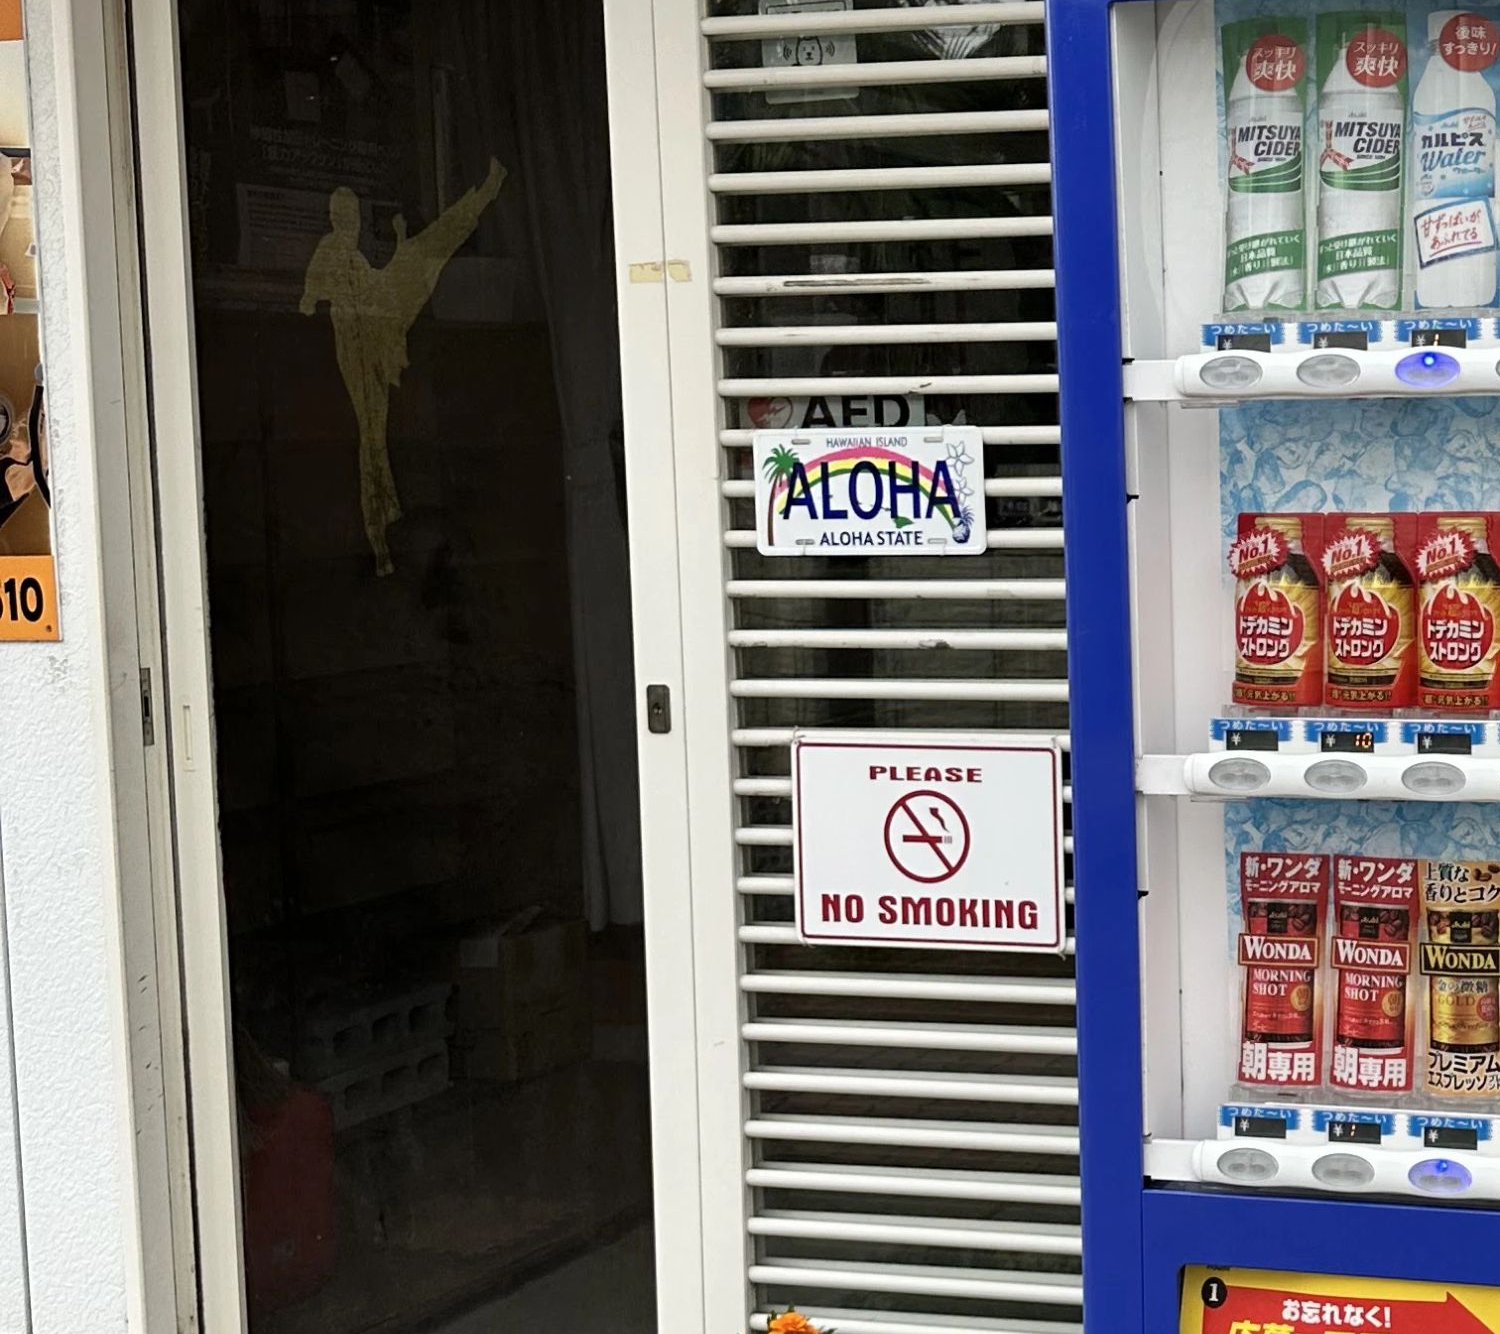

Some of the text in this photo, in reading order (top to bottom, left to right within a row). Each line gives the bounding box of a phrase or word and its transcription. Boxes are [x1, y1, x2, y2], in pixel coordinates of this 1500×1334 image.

[1354, 43, 1399, 53] スッキリ
[1443, 43, 1498, 56] すっきり!
[1354, 56, 1399, 77] 爽快
[1421, 133, 1484, 149] カルピス
[1418, 149, 1487, 174] Water
[826, 437, 907, 447] HAWAIIAN ISLAND
[783, 461, 961, 519] ALOHA
[820, 531, 923, 546] ALOHA STATE
[0, 578, 44, 622] 10
[1240, 638, 1290, 657] ストロング
[1332, 639, 1384, 657] ストロング
[1430, 642, 1482, 661] ストロング
[869, 766, 982, 783] PLEASE
[1425, 862, 1469, 881] 上質な
[1245, 881, 1321, 894] モーニングアロマ
[821, 894, 1038, 929] NO SMOKING
[1244, 936, 1312, 960] WONDA
[1425, 945, 1496, 970] WONDA
[1253, 969, 1311, 981] MORNING
[1252, 983, 1287, 996] SHOT
[1242, 1041, 1315, 1082] 朝専用
[1428, 1071, 1488, 1090] エスプレッソ
[1282, 1300, 1392, 1328] お忘れなく!
